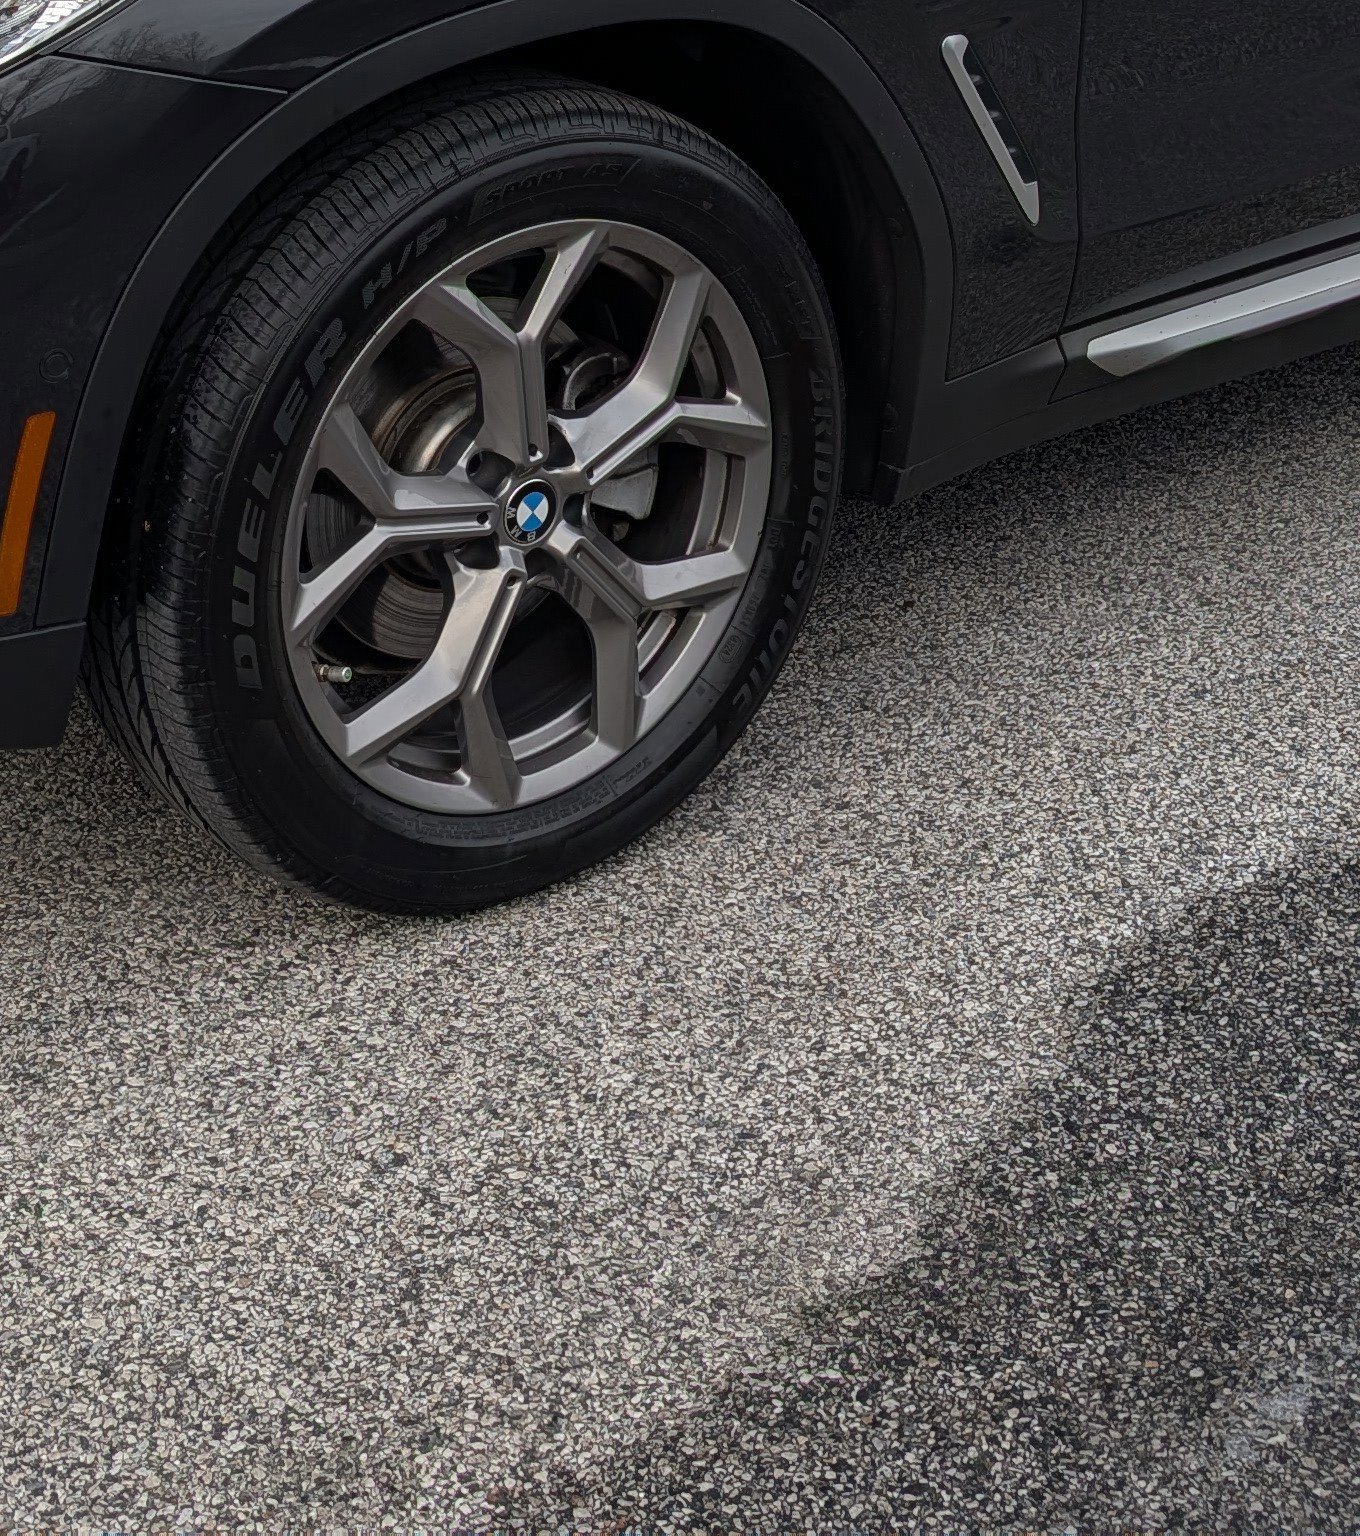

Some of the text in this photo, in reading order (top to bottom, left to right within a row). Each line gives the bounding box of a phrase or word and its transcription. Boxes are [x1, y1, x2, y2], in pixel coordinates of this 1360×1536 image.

[484, 165, 576, 207] SPORT
[231, 217, 448, 691] DUELER H/P
[506, 506, 536, 542] BMW
[732, 368, 837, 714] BRIDGESTONE
